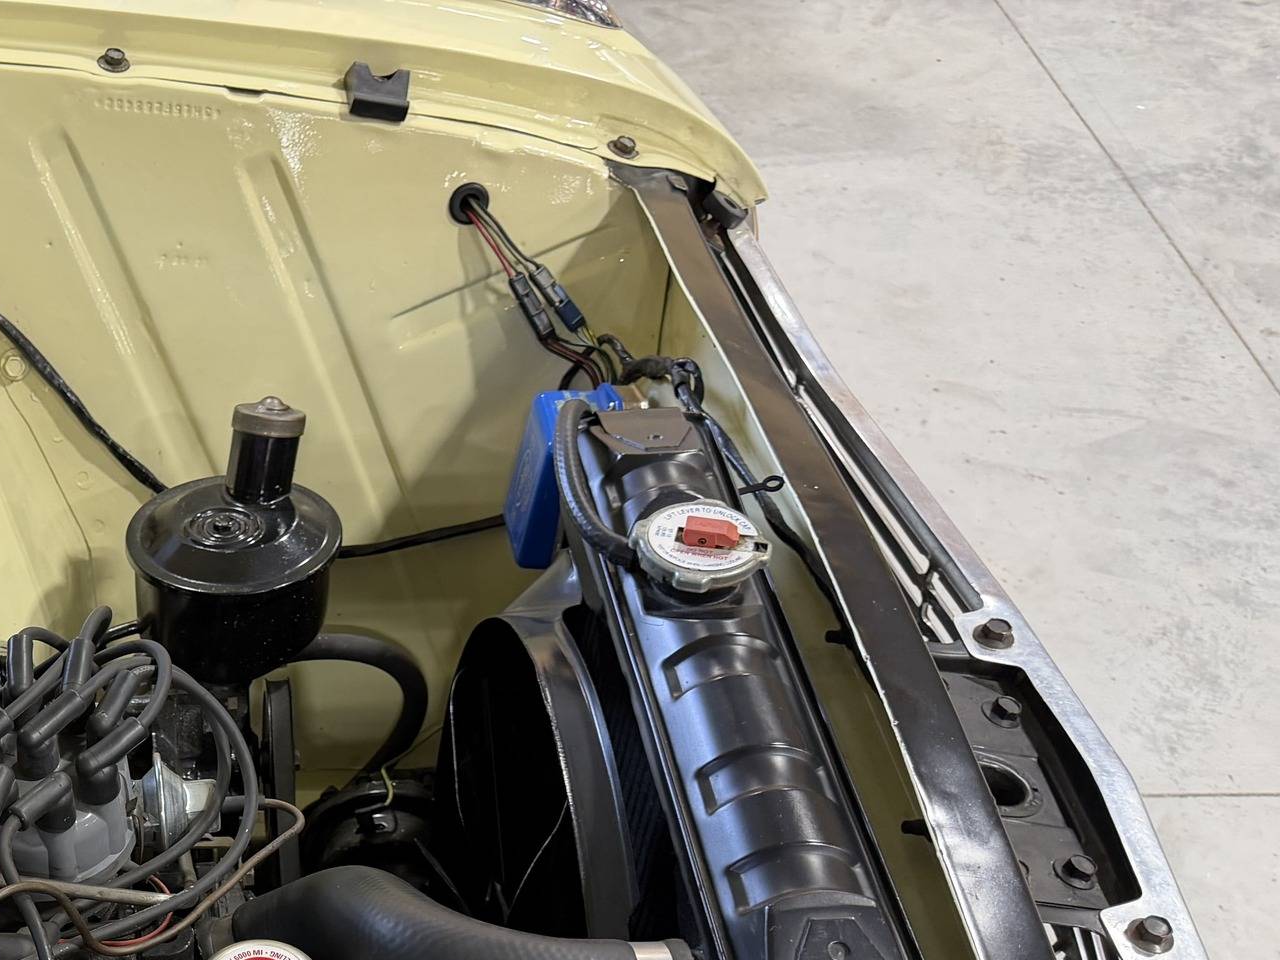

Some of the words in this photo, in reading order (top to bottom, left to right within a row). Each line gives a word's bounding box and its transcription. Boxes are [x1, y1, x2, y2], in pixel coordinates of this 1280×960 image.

[677, 507, 700, 515] LEVER
[713, 509, 739, 522] UNLOCK
[739, 521, 752, 531] CAP
